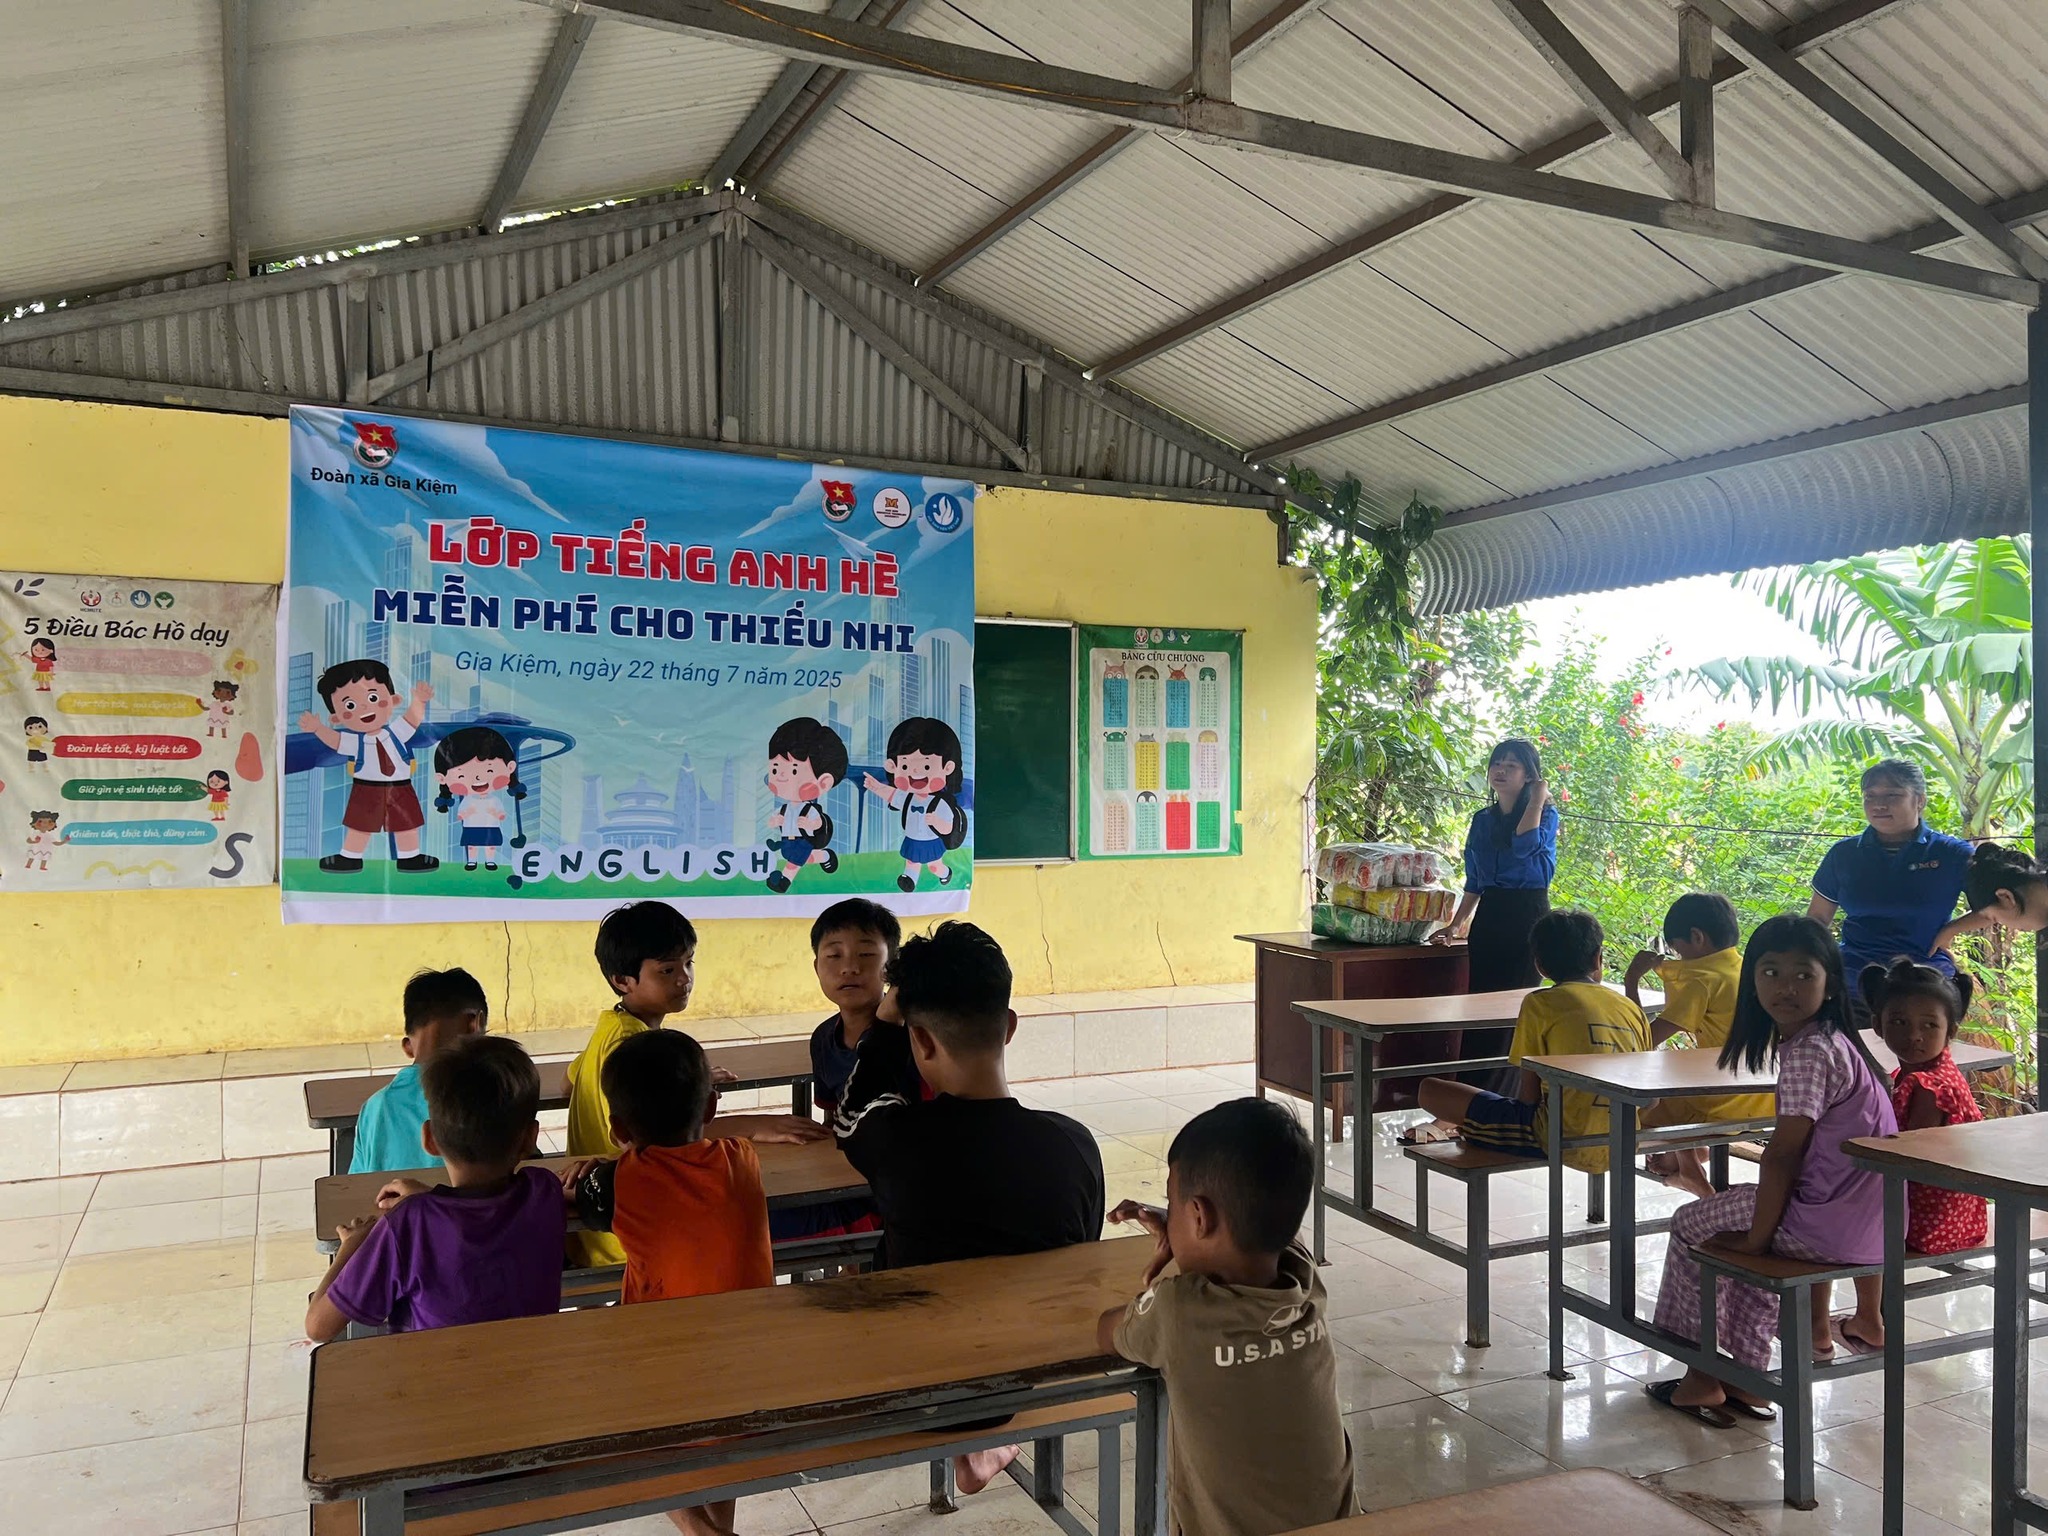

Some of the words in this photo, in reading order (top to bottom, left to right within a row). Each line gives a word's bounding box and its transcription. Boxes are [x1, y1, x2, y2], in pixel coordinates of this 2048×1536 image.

[310, 467, 355, 484] Đoàn
[360, 472, 380, 486] xã
[384, 475, 411, 489] Gia
[416, 478, 457, 495] Kiệm
[428, 515, 540, 568] LỚP
[551, 517, 717, 584] TIẾNG
[728, 548, 828, 593] ANH
[840, 551, 899, 598] HÈ
[373, 574, 500, 628] MIỄN
[513, 594, 599, 634] PHÍ
[609, 605, 694, 641] CHO
[704, 600, 832, 649] THIẾU
[842, 621, 915, 653] NHI
[24, 618, 40, 635] 5
[46, 616, 99, 637] Điều
[104, 620, 148, 639] Bác
[152, 620, 185, 641] Hồ
[190, 622, 230, 647] dạy
[455, 651, 492, 671] Gia
[500, 653, 561, 677] Kiệm,
[569, 657, 622, 681] ngày
[628, 660, 655, 679] 22
[661, 661, 720, 687] tháng
[728, 665, 740, 683] 7
[744, 667, 787, 686] năm
[793, 669, 842, 688] 2025
[1121, 650, 1146, 661] BẢNG
[66, 743, 93, 753] Đoàn
[94, 743, 112, 753] kết
[114, 744, 133, 754] tốt,
[135, 744, 149, 755] kỹ
[150, 745, 170, 755] luật
[172, 744, 188, 754] tốt
[78, 785, 96, 793] Giữ
[97, 785, 112, 795] gìn
[113, 785, 124, 794] vệ
[126, 785, 145, 794] sinh
[146, 785, 167, 794] thật
[168, 785, 183, 793] tốt
[521, 849, 769, 878] ENGLISH
[1215, 1339, 1285, 1367] U.S.A
